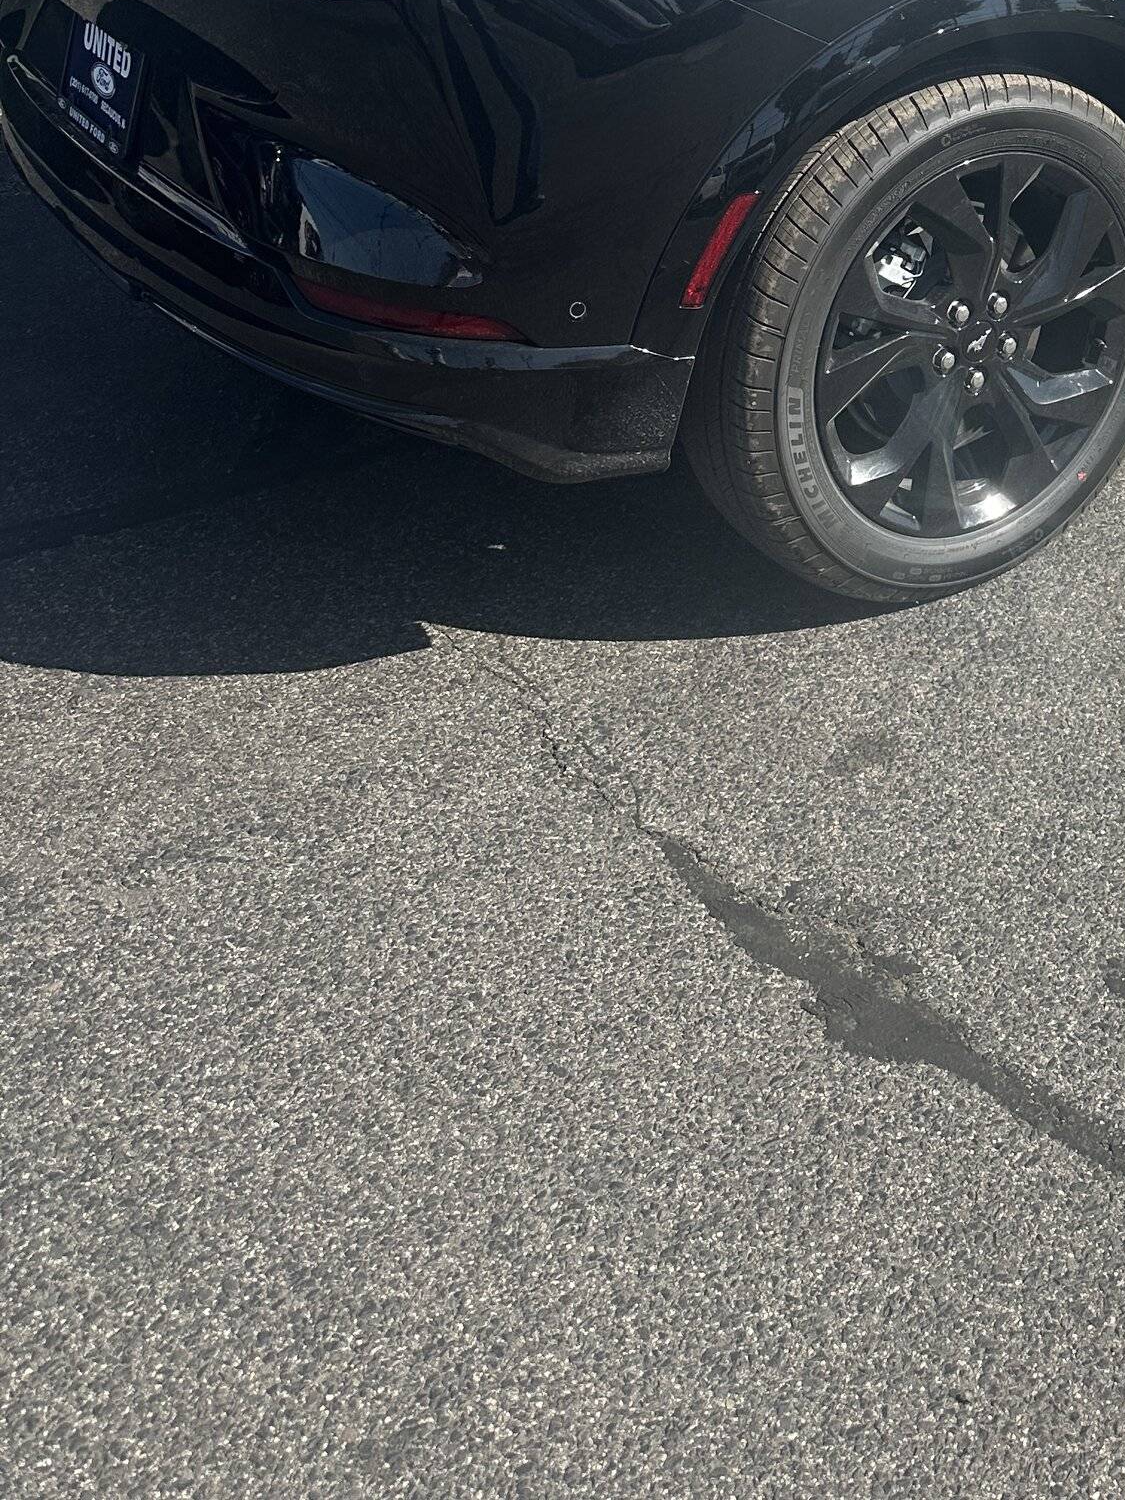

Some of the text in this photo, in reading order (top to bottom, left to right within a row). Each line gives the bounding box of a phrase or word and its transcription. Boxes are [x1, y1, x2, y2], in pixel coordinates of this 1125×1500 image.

[83, 22, 132, 79] UNITED
[69, 106, 106, 144] UNITED FORD
[788, 396, 838, 531] MICHELIN
